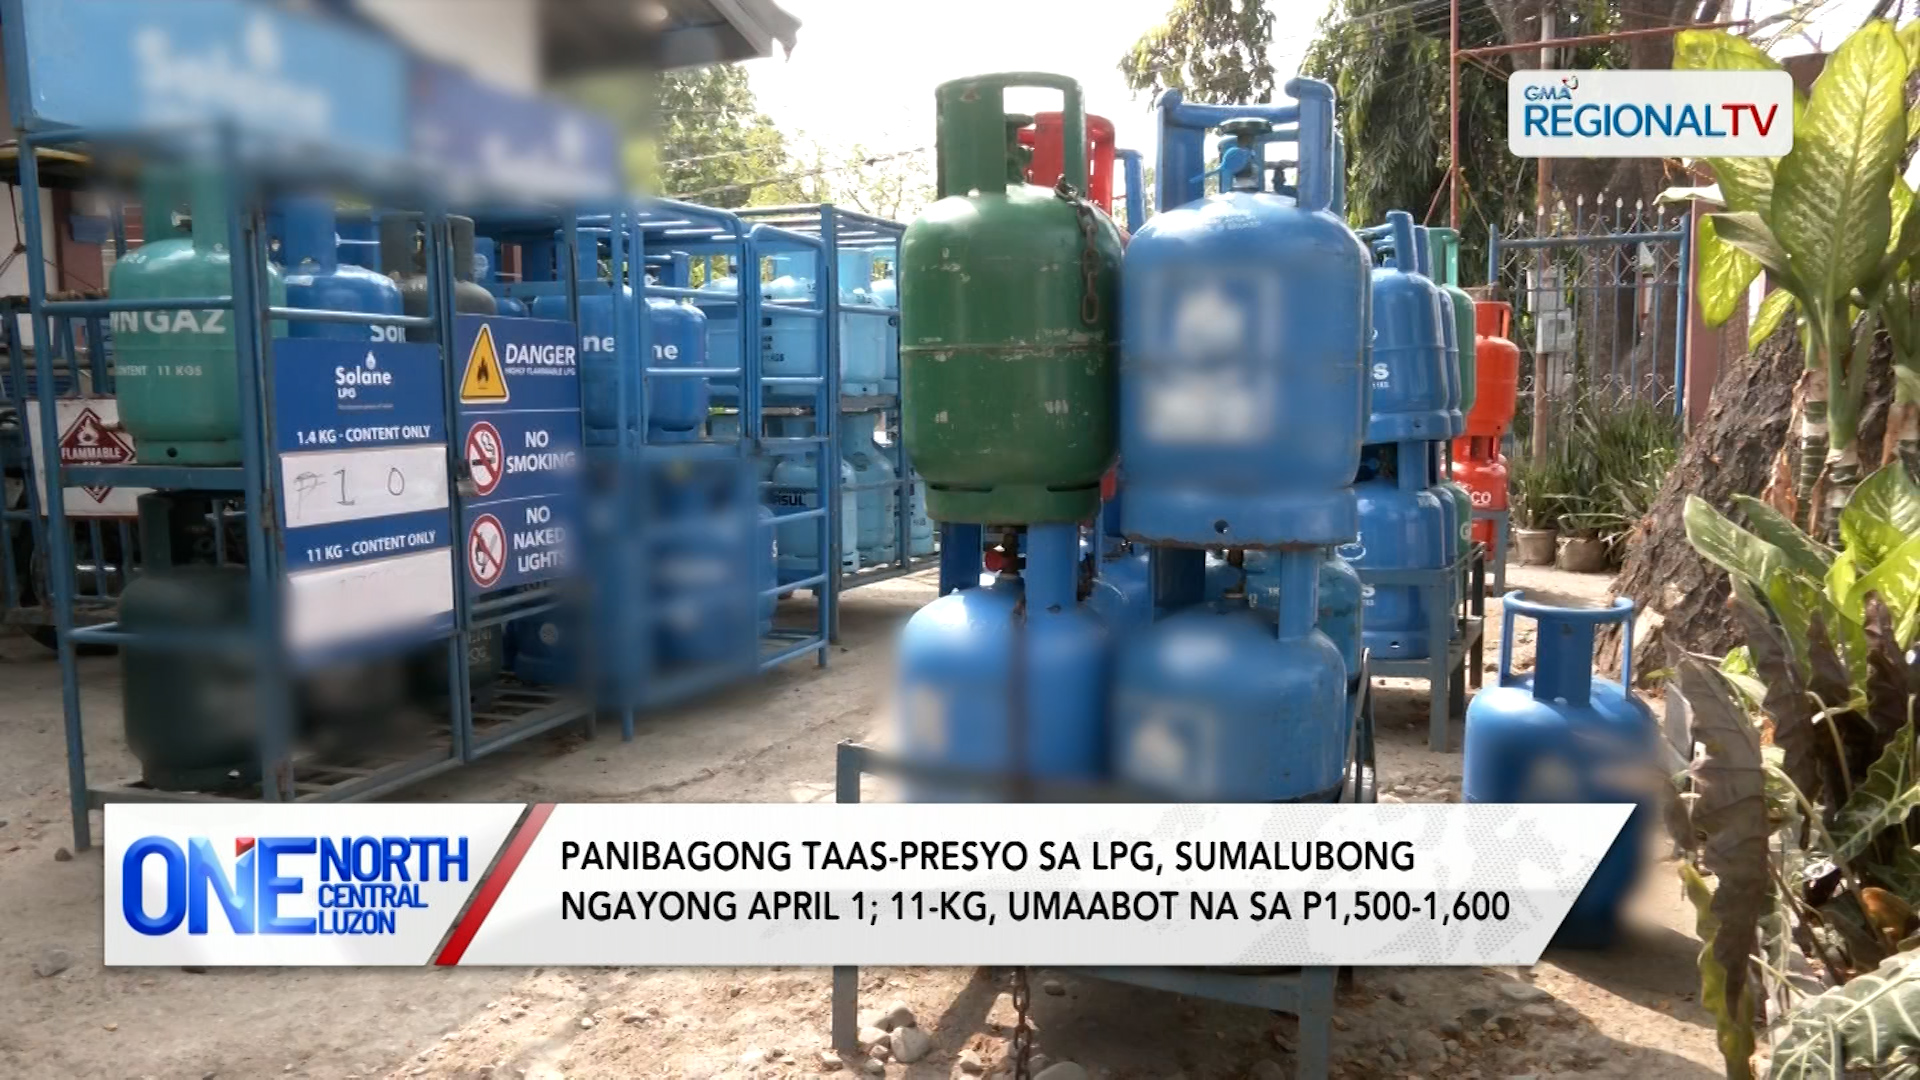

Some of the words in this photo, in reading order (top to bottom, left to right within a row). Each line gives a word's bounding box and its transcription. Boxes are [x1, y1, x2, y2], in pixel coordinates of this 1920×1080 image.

[505, 343, 576, 366] DANGER
[335, 365, 393, 386] Solane
[296, 431, 317, 445] 1.4
[318, 429, 337, 444] KG
[345, 426, 401, 442] CONTENT
[401, 425, 431, 439] ONLY
[525, 430, 549, 448] NO
[61, 447, 122, 460] FLAMMABLE
[506, 451, 577, 474] SMOKING
[526, 505, 551, 524] NO
[306, 547, 321, 562] 11
[324, 544, 342, 560] KG
[351, 534, 406, 556] CONTENT
[407, 529, 437, 546] ONLY
[513, 527, 567, 550] NAKED
